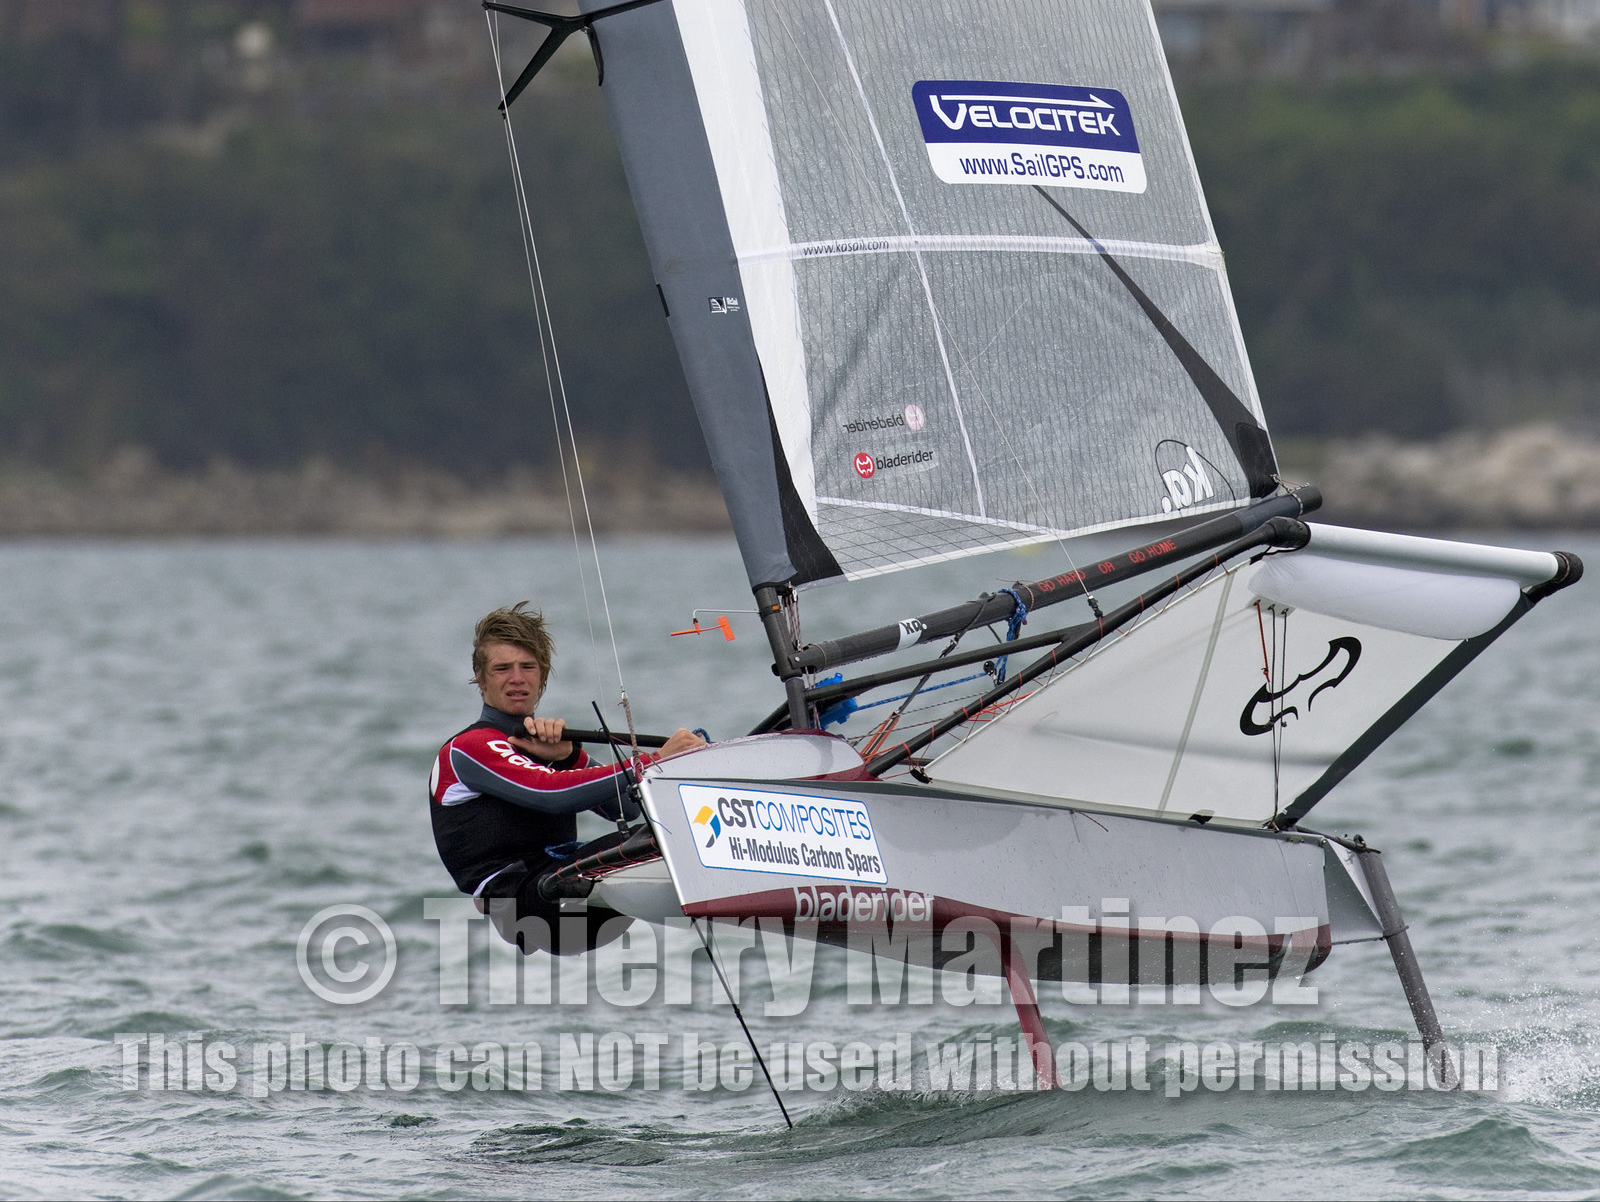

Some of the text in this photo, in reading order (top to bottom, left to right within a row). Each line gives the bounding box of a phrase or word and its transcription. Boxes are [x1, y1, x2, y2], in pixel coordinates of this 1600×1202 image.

[929, 95, 1121, 136] VELOCITEK
[959, 152, 1125, 183] www.SailGPS.com
[803, 240, 889, 256] www.kasail.com
[876, 450, 934, 470] bladerider
[1037, 539, 1178, 592] GO HARD OR GO HOME
[728, 836, 881, 877] Hi-Modulus Carbon Spars
[793, 885, 936, 922] bladerider
